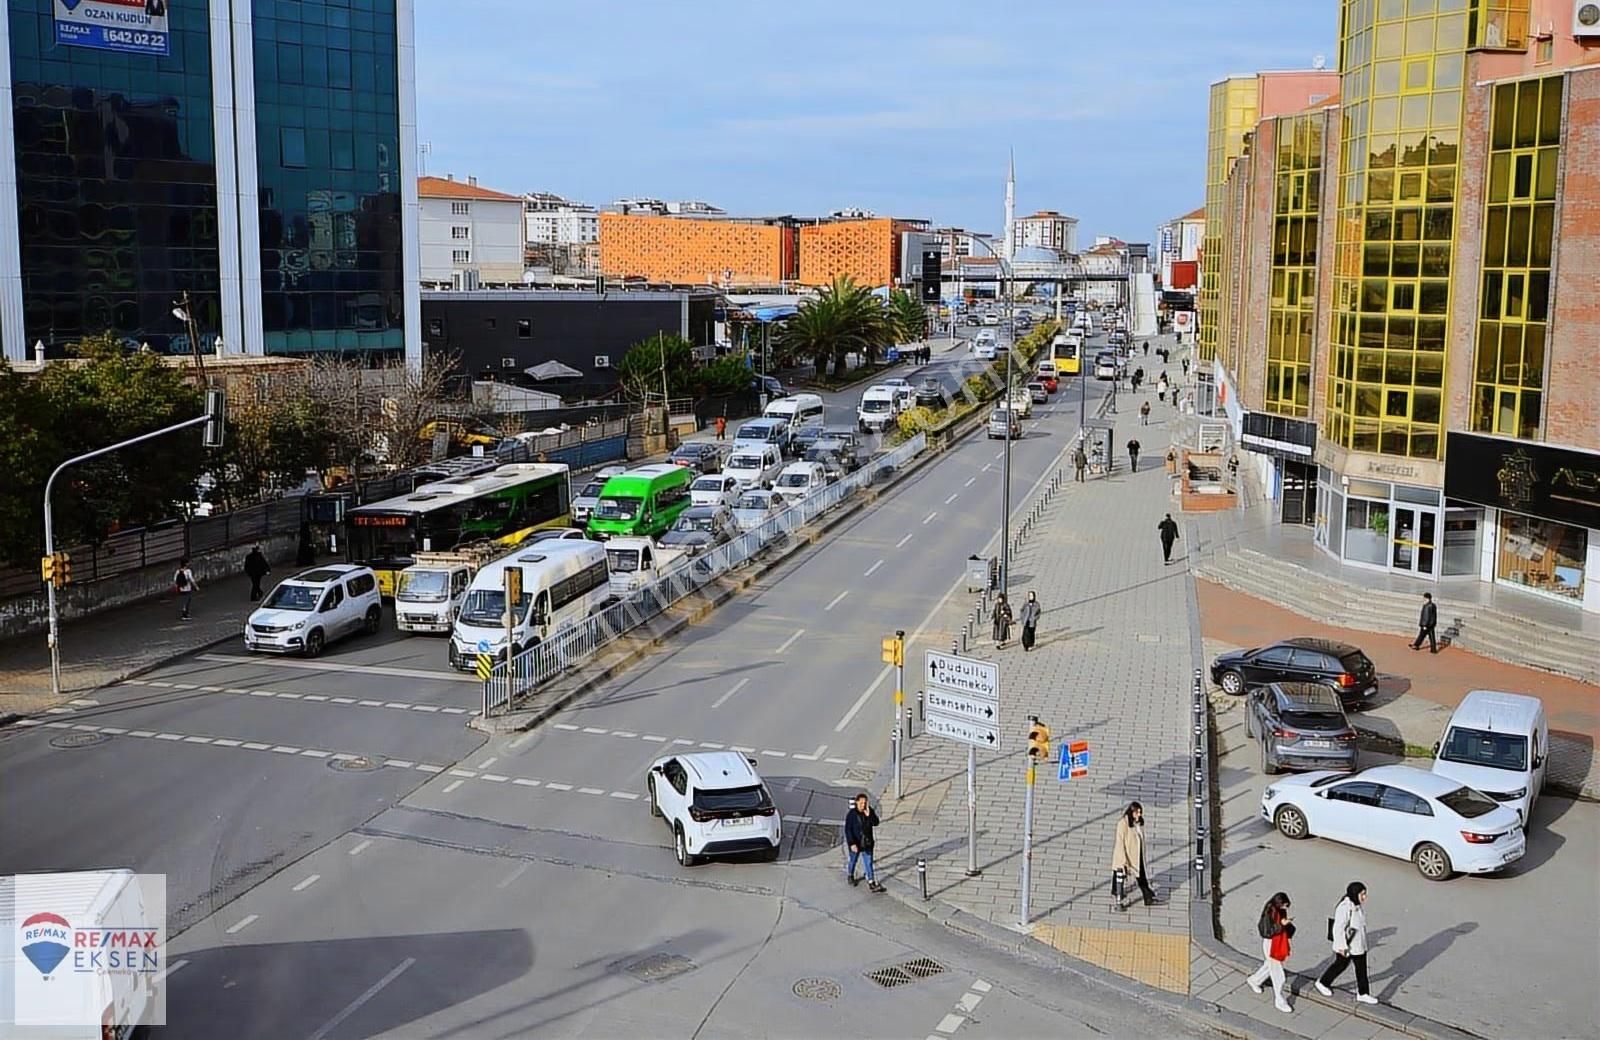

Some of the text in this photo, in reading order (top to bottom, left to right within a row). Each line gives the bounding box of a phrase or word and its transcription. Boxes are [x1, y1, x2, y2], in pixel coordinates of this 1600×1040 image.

[84, 8, 114, 20] OZAN
[109, 30, 132, 43] 642
[134, 33, 149, 45] 02
[150, 34, 166, 47] 22
[939, 659, 987, 679] Dudullu
